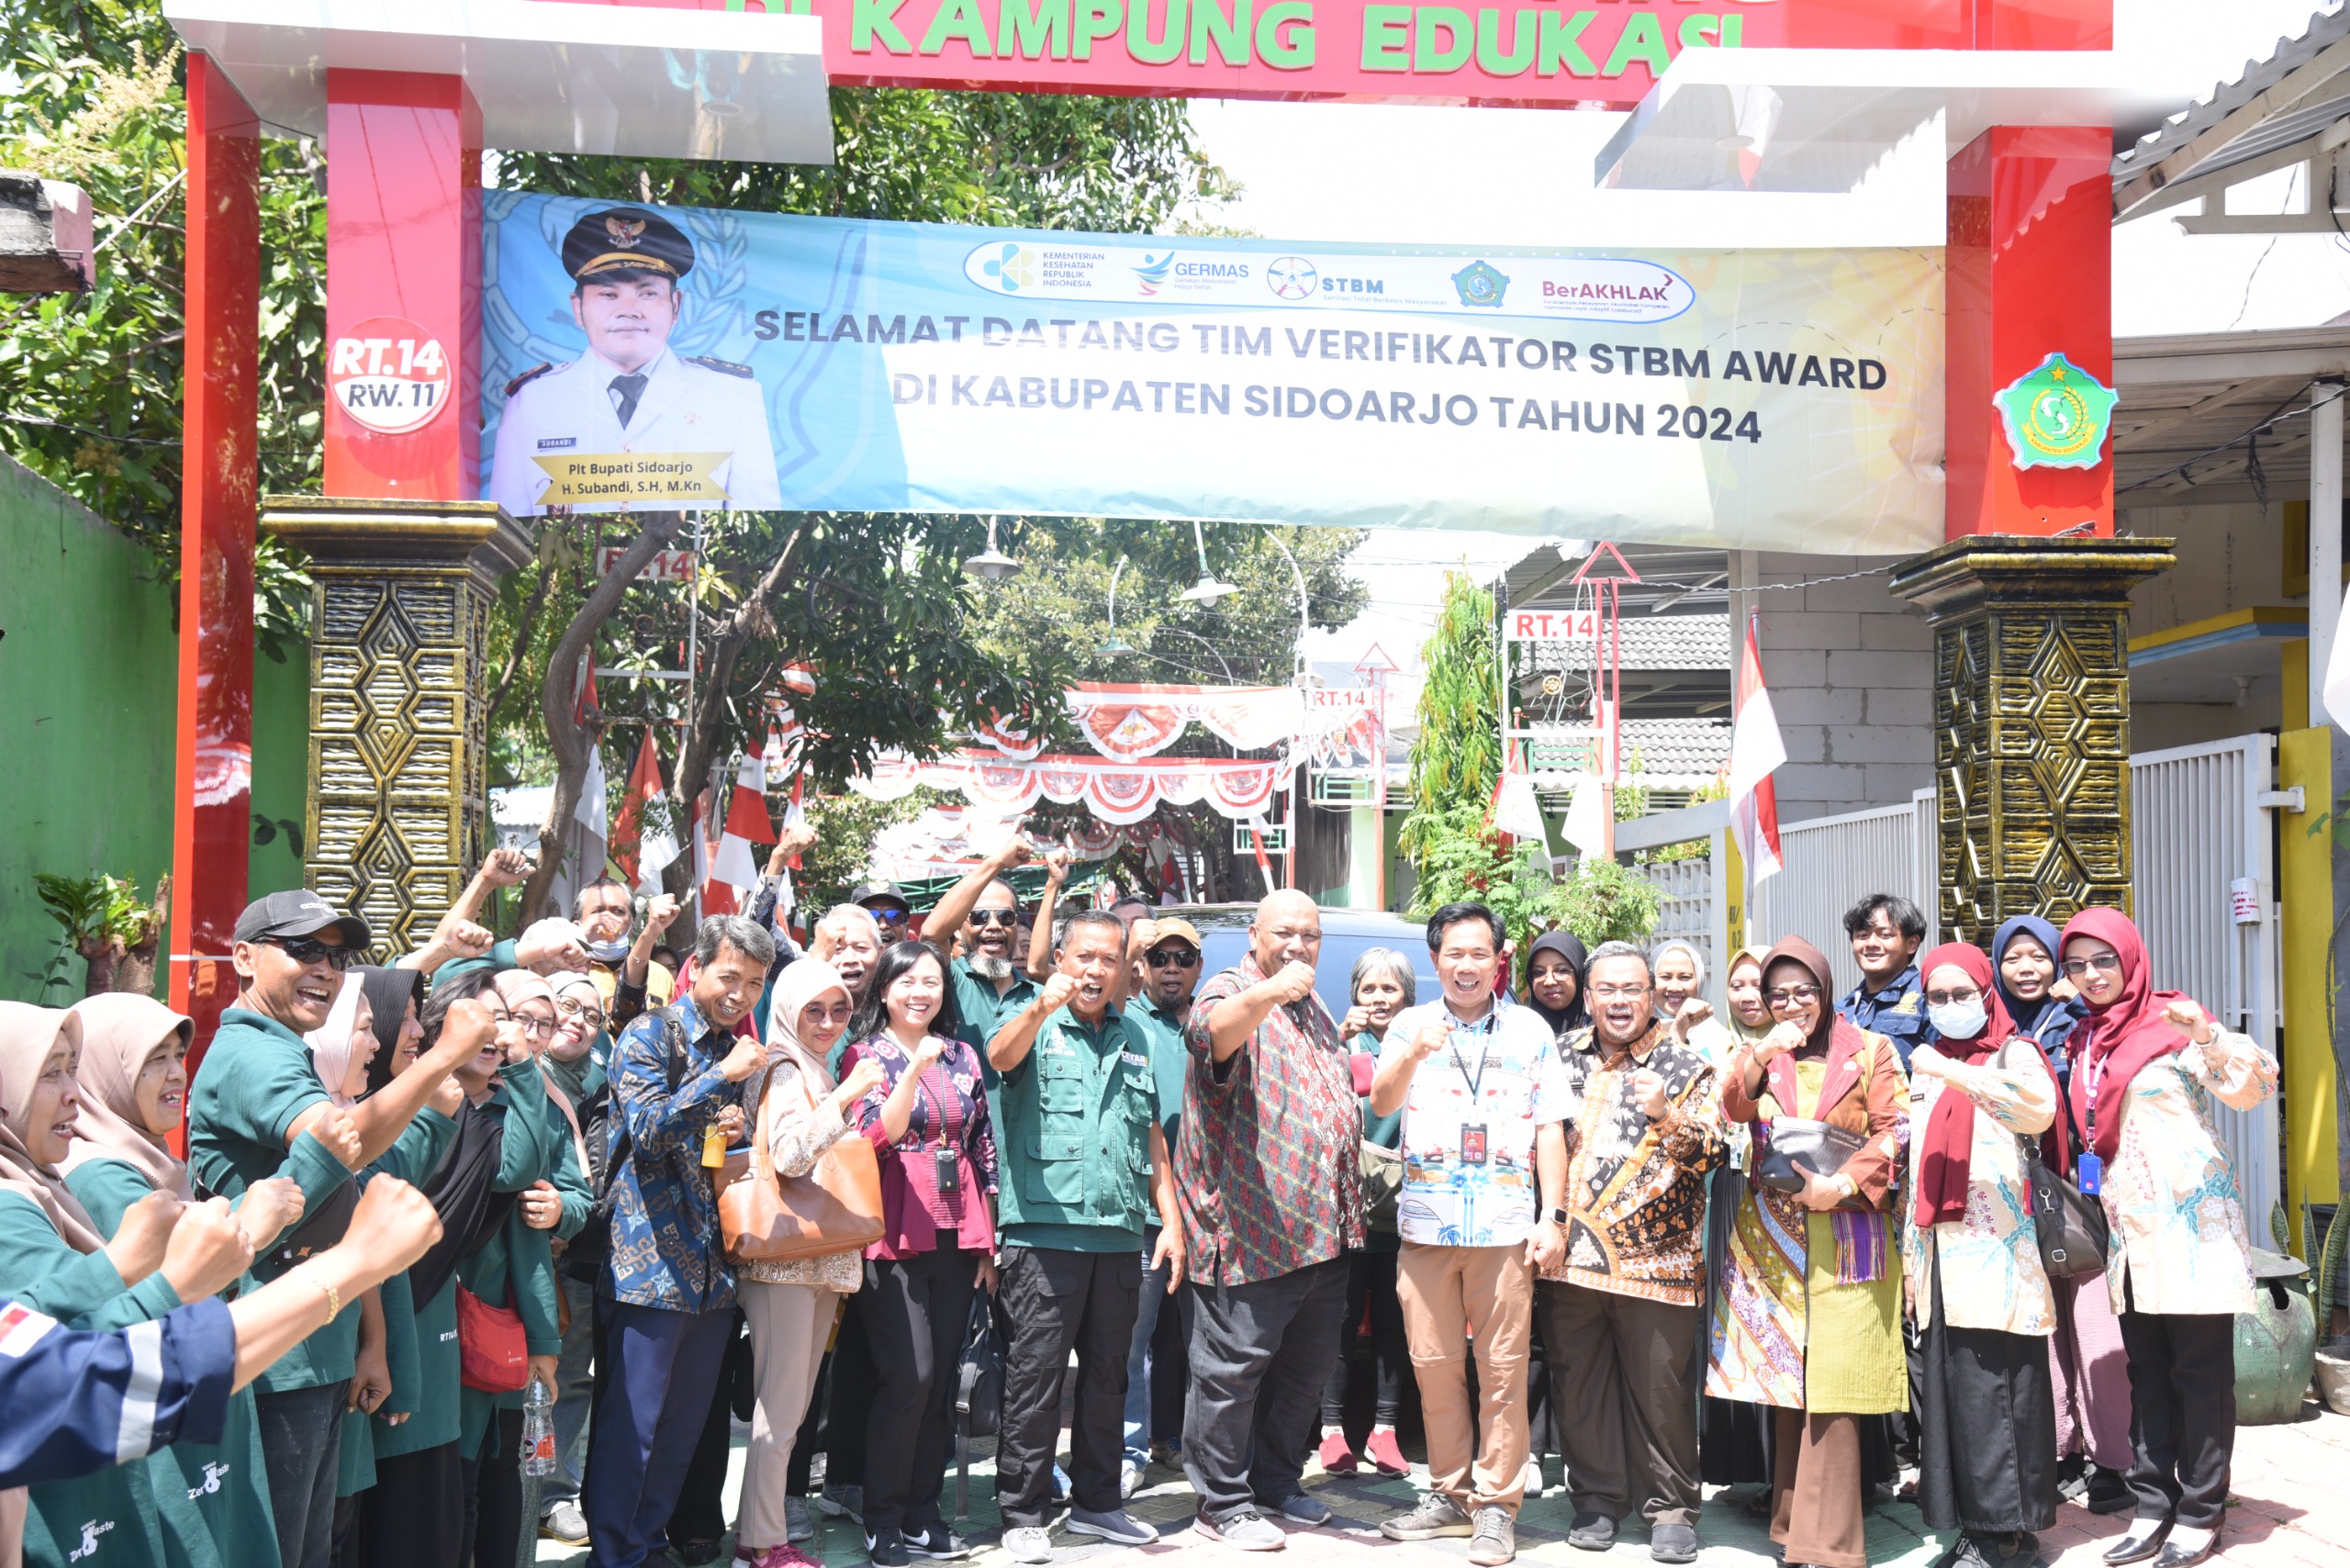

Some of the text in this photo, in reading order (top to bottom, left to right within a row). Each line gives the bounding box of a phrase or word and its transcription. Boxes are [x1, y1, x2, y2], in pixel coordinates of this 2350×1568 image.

[850, 0, 1316, 70] KAMPUNG
[1043, 252, 1105, 261] KEMENTERIAN
[1043, 261, 1094, 270] KESEHATAN
[1174, 263, 1249, 278] GERMAS
[1043, 270, 1085, 279] REPUBLIK
[1043, 279, 1092, 288] INDONESIA
[1322, 277, 1384, 295] STBM
[1542, 279, 1669, 301] BerAKHLAK
[1323, 294, 1352, 302] Sanitasi
[1404, 298, 1448, 307] Masyarakat
[332, 338, 443, 375] RT.14
[754, 309, 1887, 391] SELAMAT DATANG TIM VERIFIKATOR STBM AWARD
[348, 384, 435, 408] RW. 11
[892, 374, 1762, 444] DI KABUPATEN SIDOARJO TAHUN 2024
[568, 461, 693, 476] Plt Bupati Sidoarjo
[562, 484, 575, 495] H.
[577, 481, 633, 494] Subandi,
[667, 480, 701, 492] M.Kn
[605, 550, 689, 577] R.14
[1516, 614, 1594, 637] RT.14
[1314, 690, 1366, 706] RT.14
